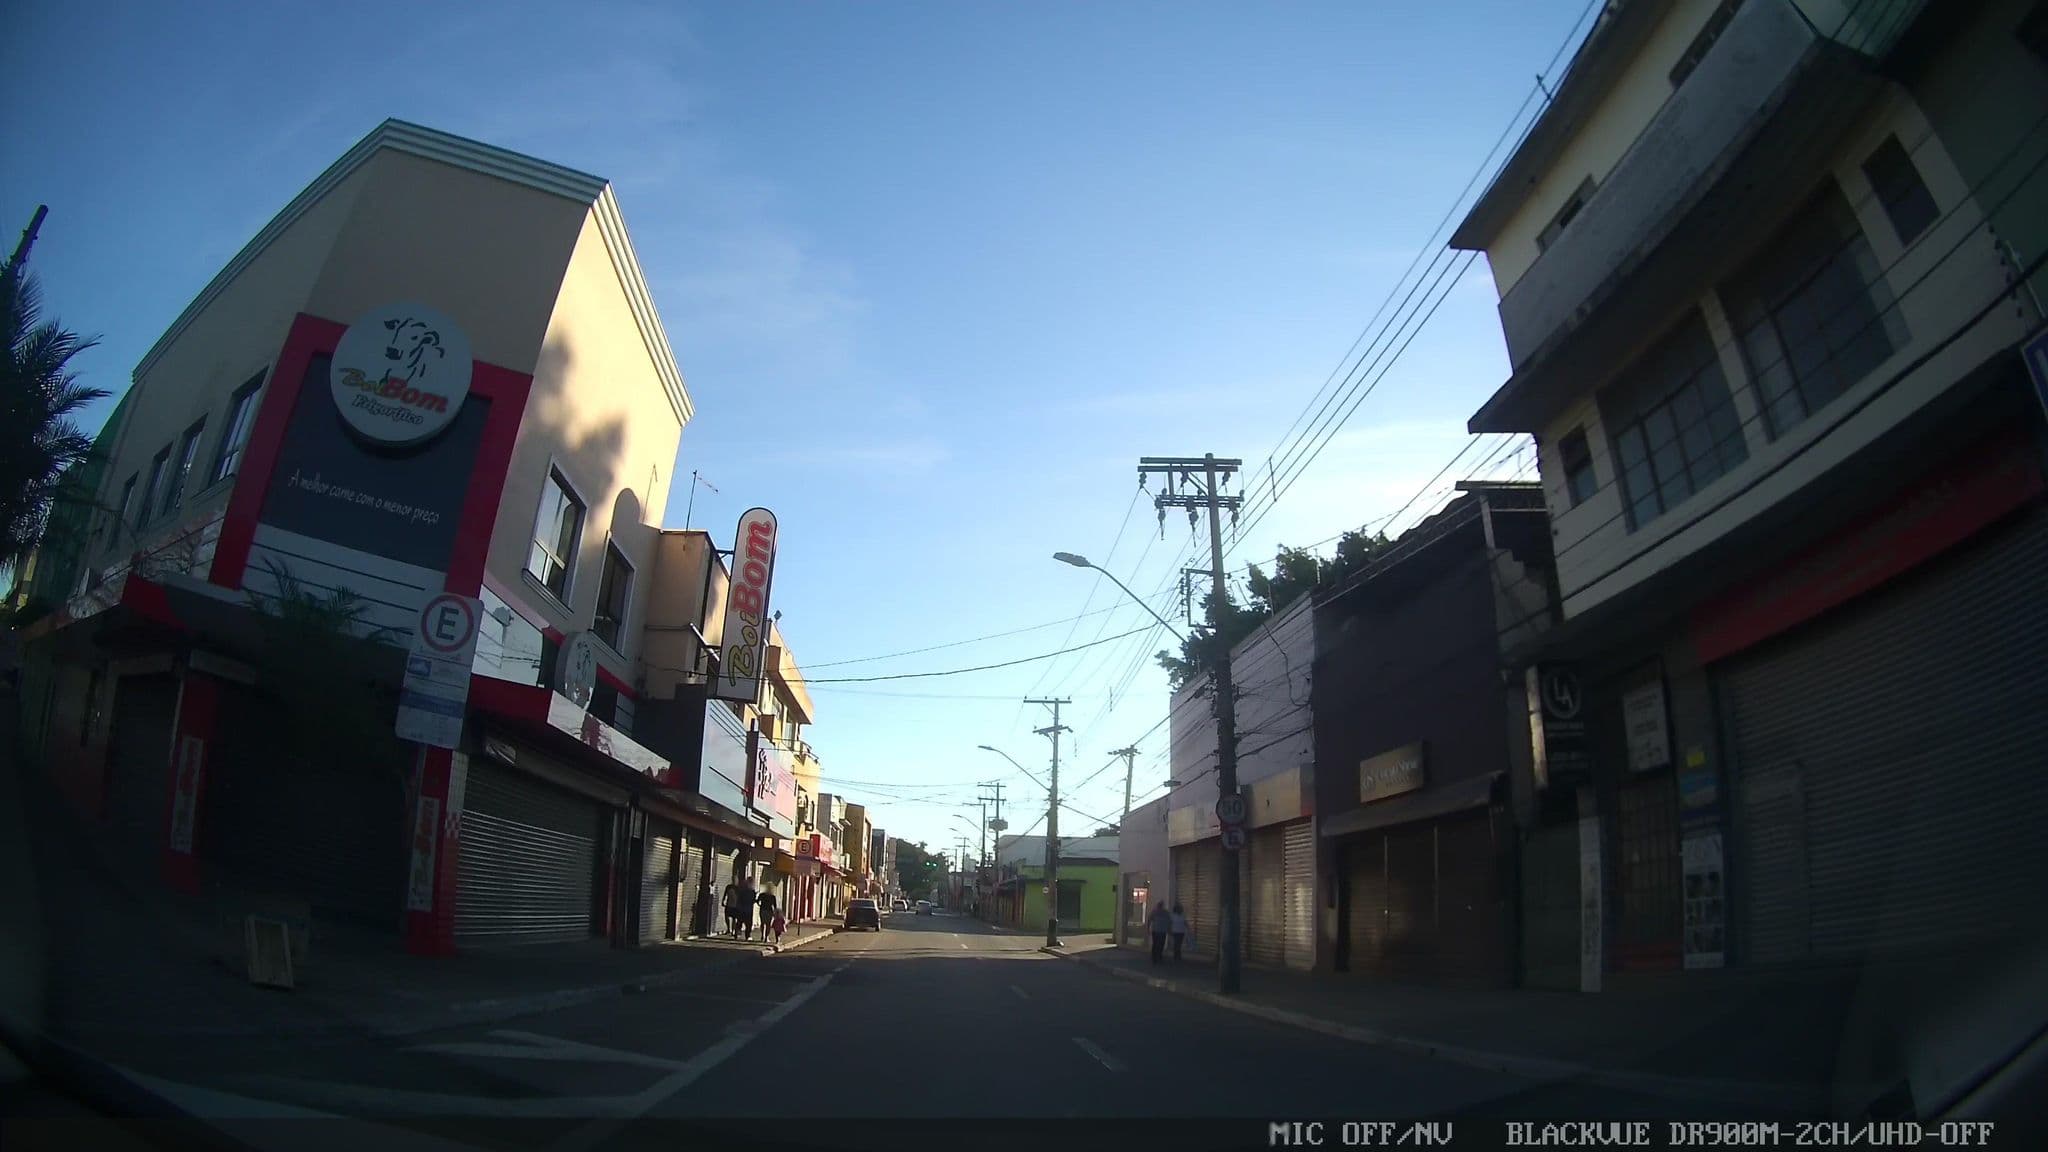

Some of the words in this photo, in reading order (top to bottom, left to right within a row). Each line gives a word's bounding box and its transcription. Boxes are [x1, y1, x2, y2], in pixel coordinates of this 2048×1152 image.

[288, 468, 300, 487] A
[300, 472, 329, 494] melhor
[329, 485, 355, 501] carne
[356, 492, 374, 507] com
[375, 498, 383, 509] o
[384, 500, 412, 516] menor
[411, 507, 440, 526] preço
[436, 606, 459, 641] E
[801, 841, 807, 851] E
